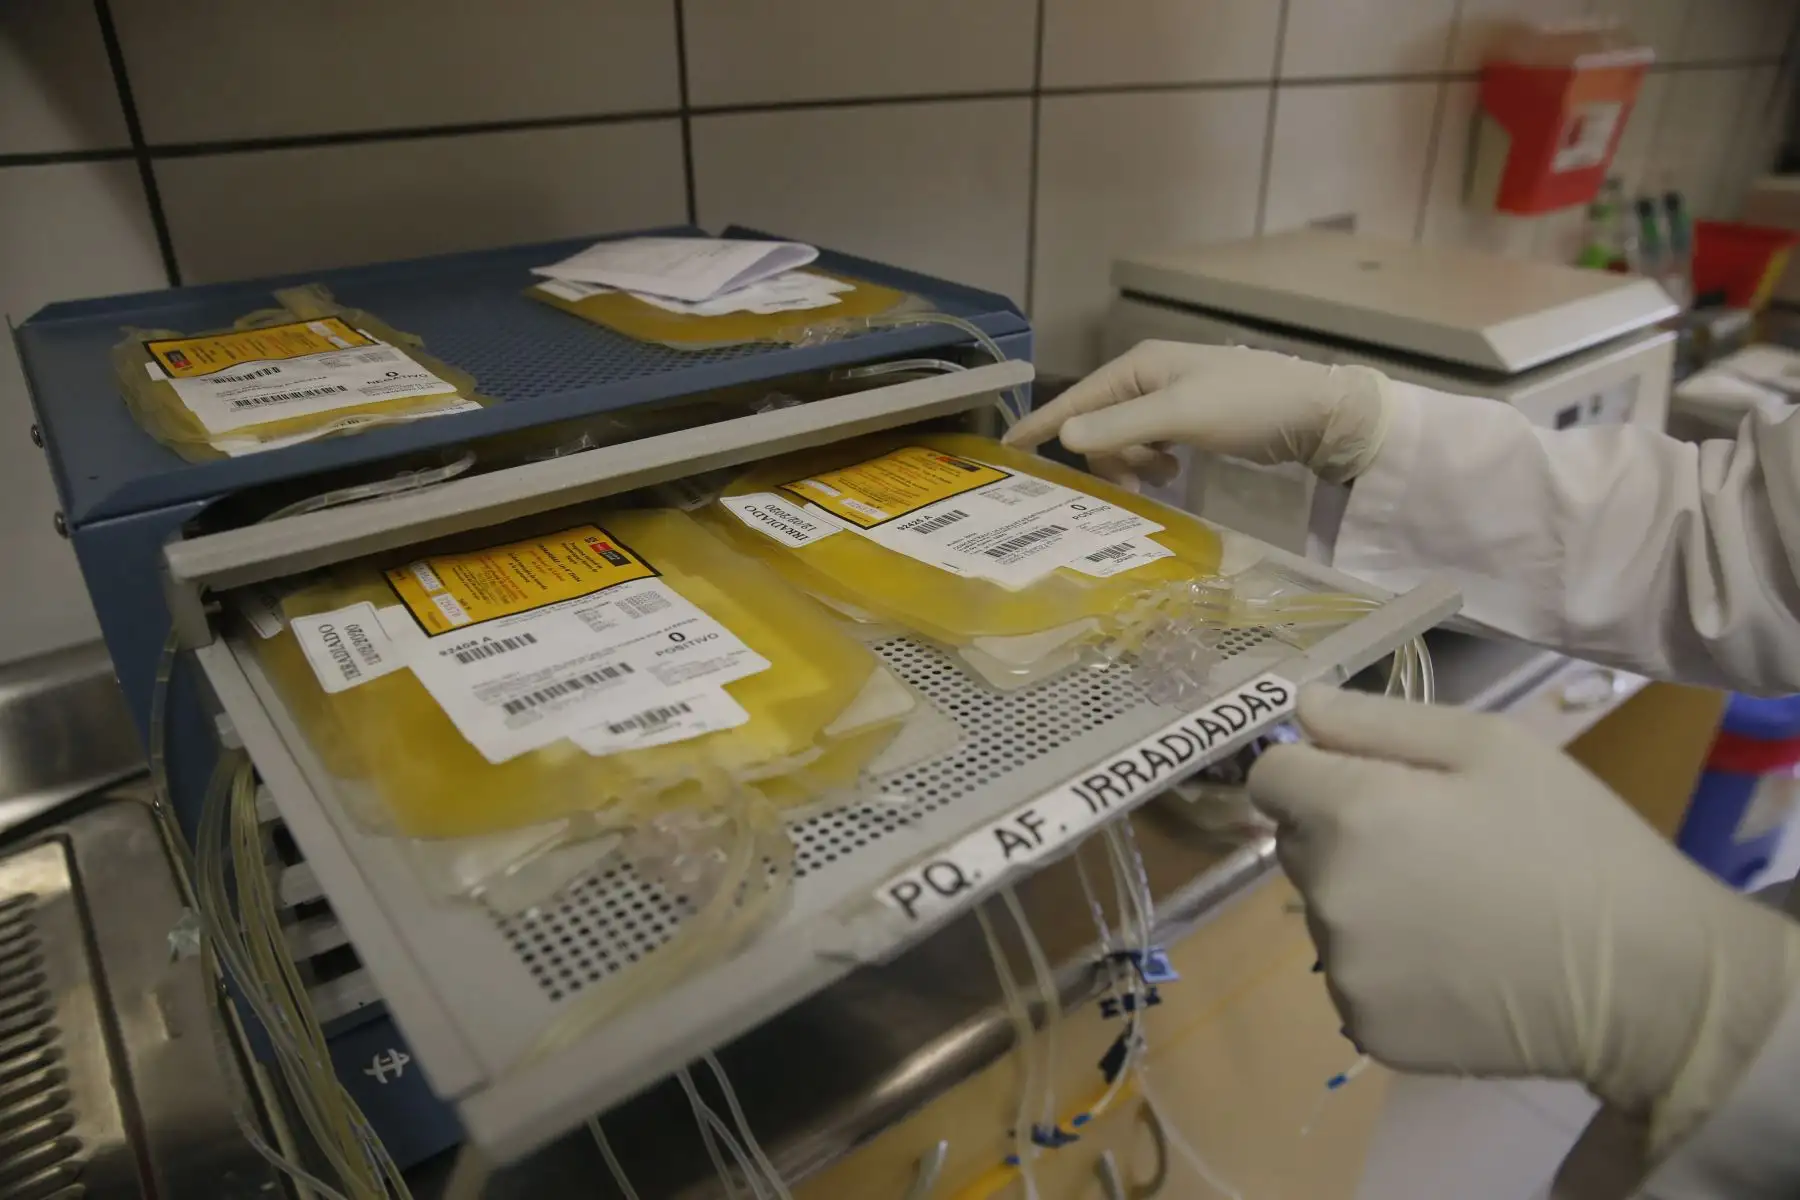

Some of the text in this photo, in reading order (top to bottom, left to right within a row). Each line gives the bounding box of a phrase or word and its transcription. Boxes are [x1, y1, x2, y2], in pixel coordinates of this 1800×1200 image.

[744, 505, 810, 541] IRRADIADO
[1072, 505, 1111, 520] POSITIVO
[318, 623, 364, 683] IRRADIADO
[654, 631, 719, 658] POSITIVO
[888, 680, 1289, 920] PQ. AF. IRRADIADAS
